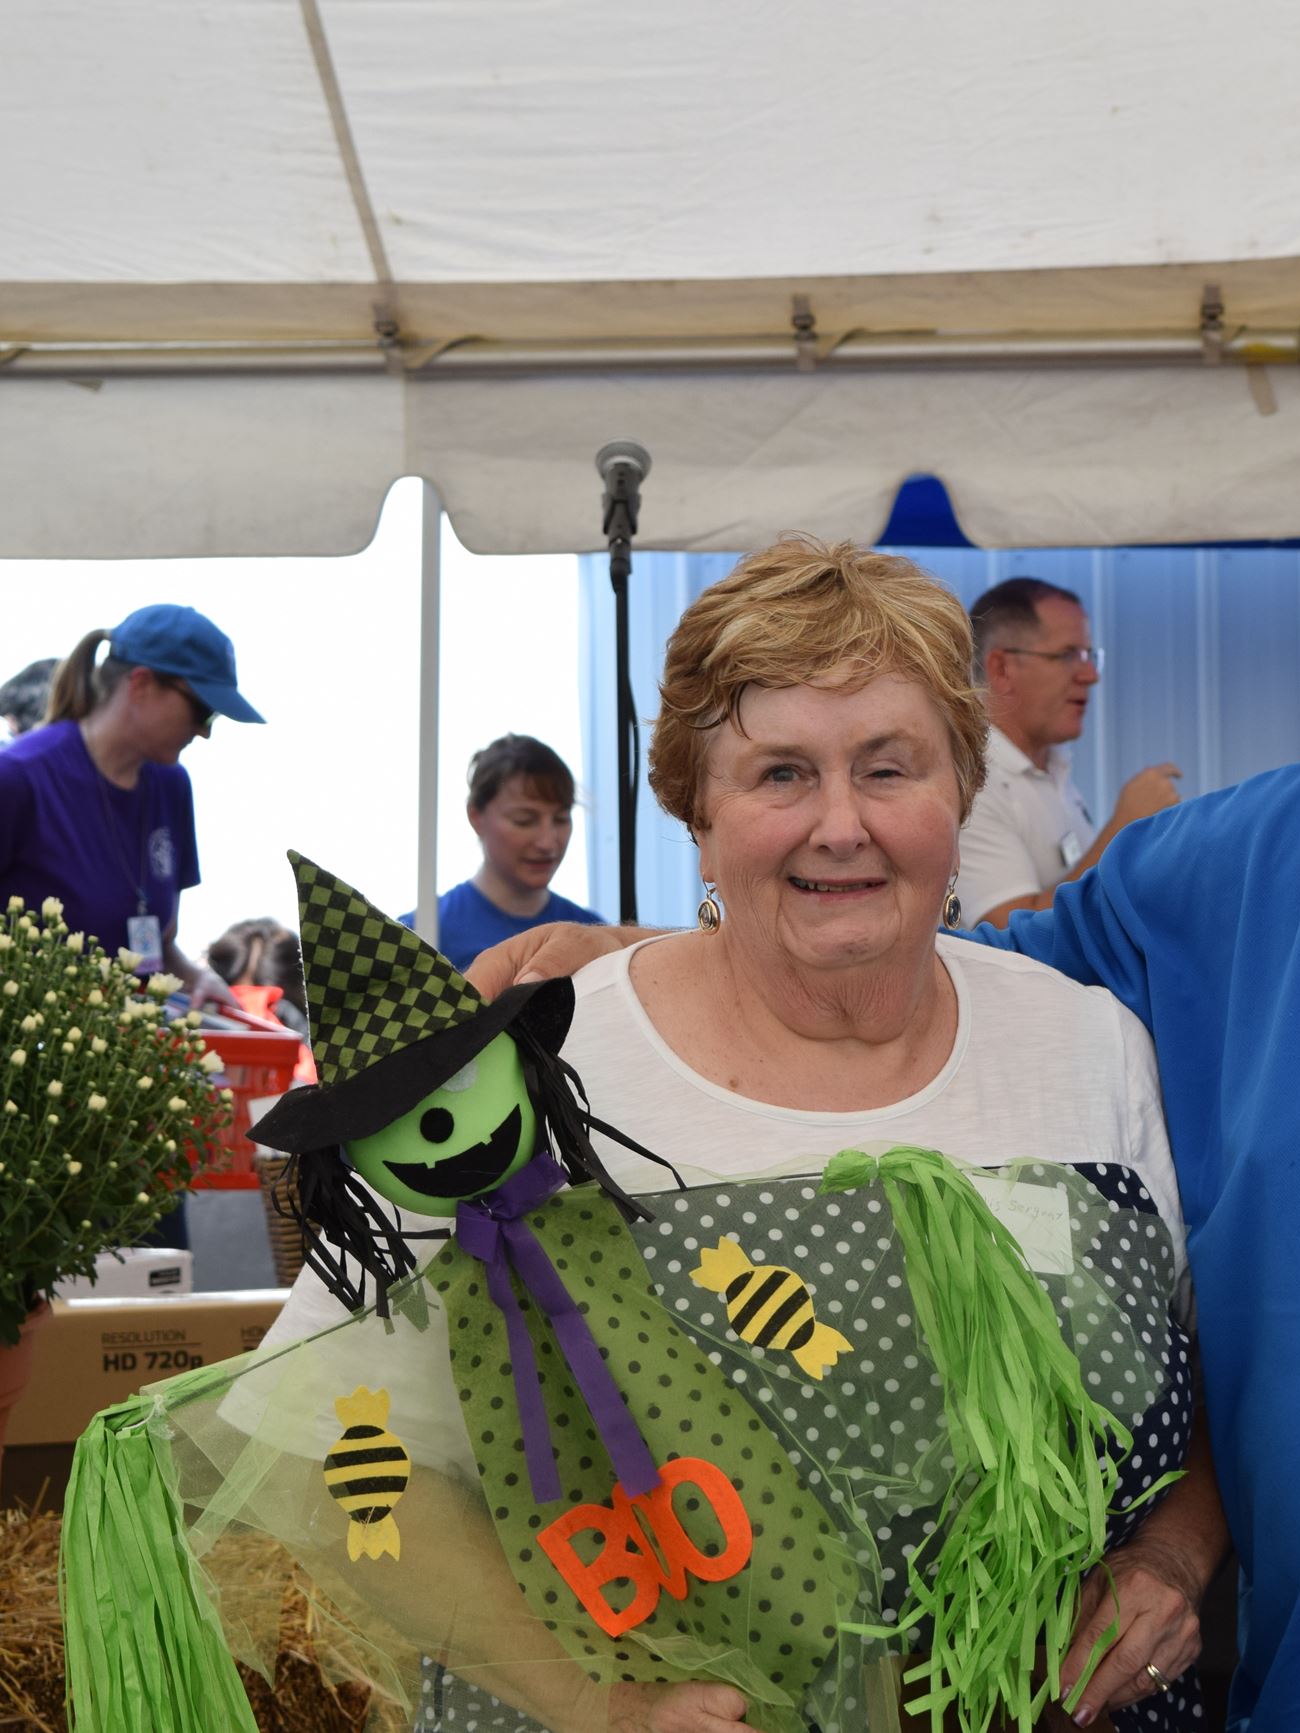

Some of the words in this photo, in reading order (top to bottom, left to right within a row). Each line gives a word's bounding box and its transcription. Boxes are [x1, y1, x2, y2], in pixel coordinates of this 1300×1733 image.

[101, 1329, 187, 1345] RESOLUTION
[103, 1353, 138, 1373] HD
[145, 1350, 204, 1369] 720p
[535, 1456, 753, 1638] BOO
